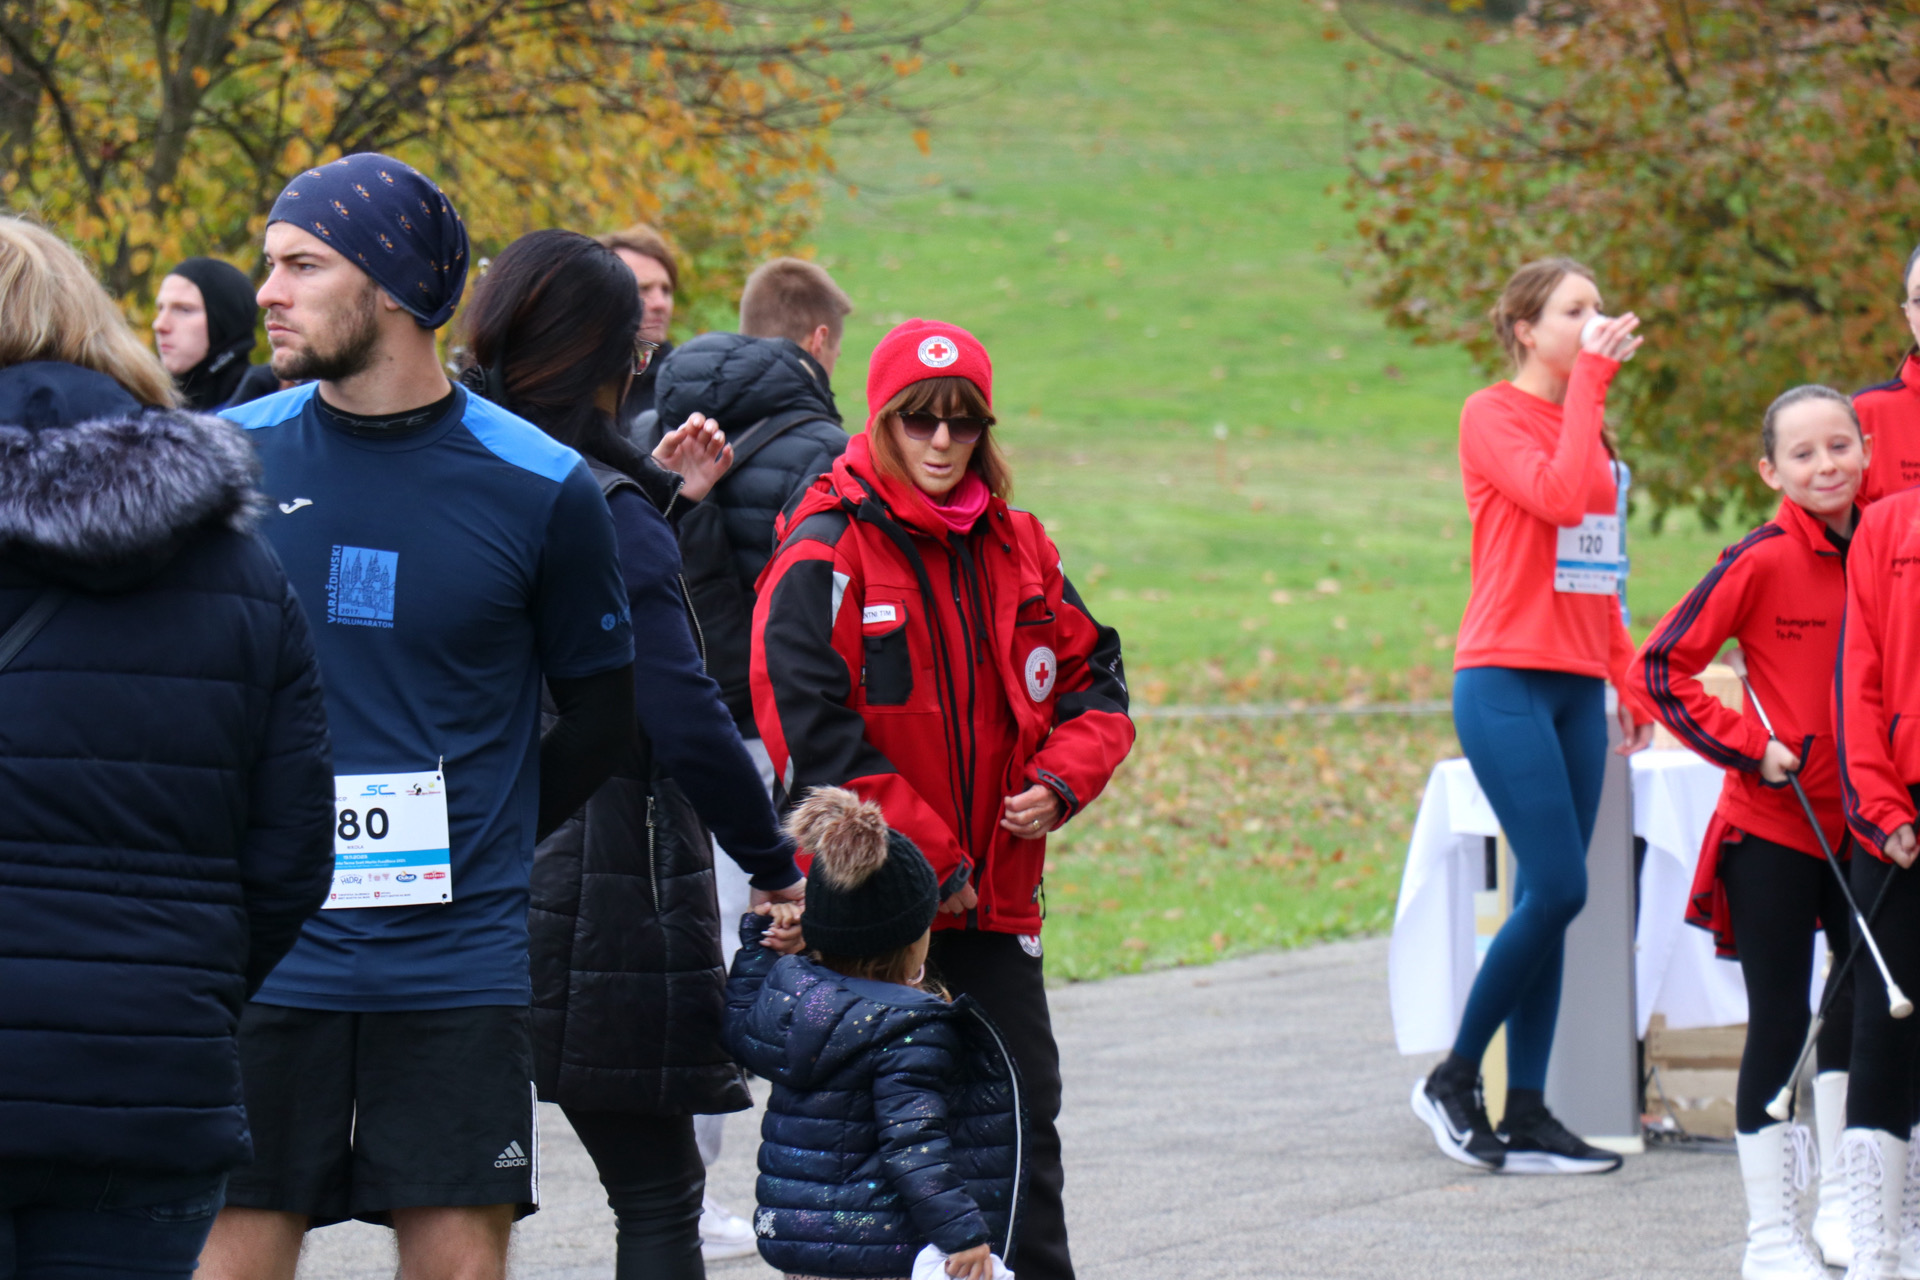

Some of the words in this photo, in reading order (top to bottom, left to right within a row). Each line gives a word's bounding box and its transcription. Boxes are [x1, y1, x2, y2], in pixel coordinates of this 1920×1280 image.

[1578, 533, 1603, 555] 120
[326, 545, 341, 623] VARAŽDINSKI
[337, 618, 394, 628] POLUMARATON
[338, 807, 389, 841] 80
[493, 1157, 529, 1168] adidas
